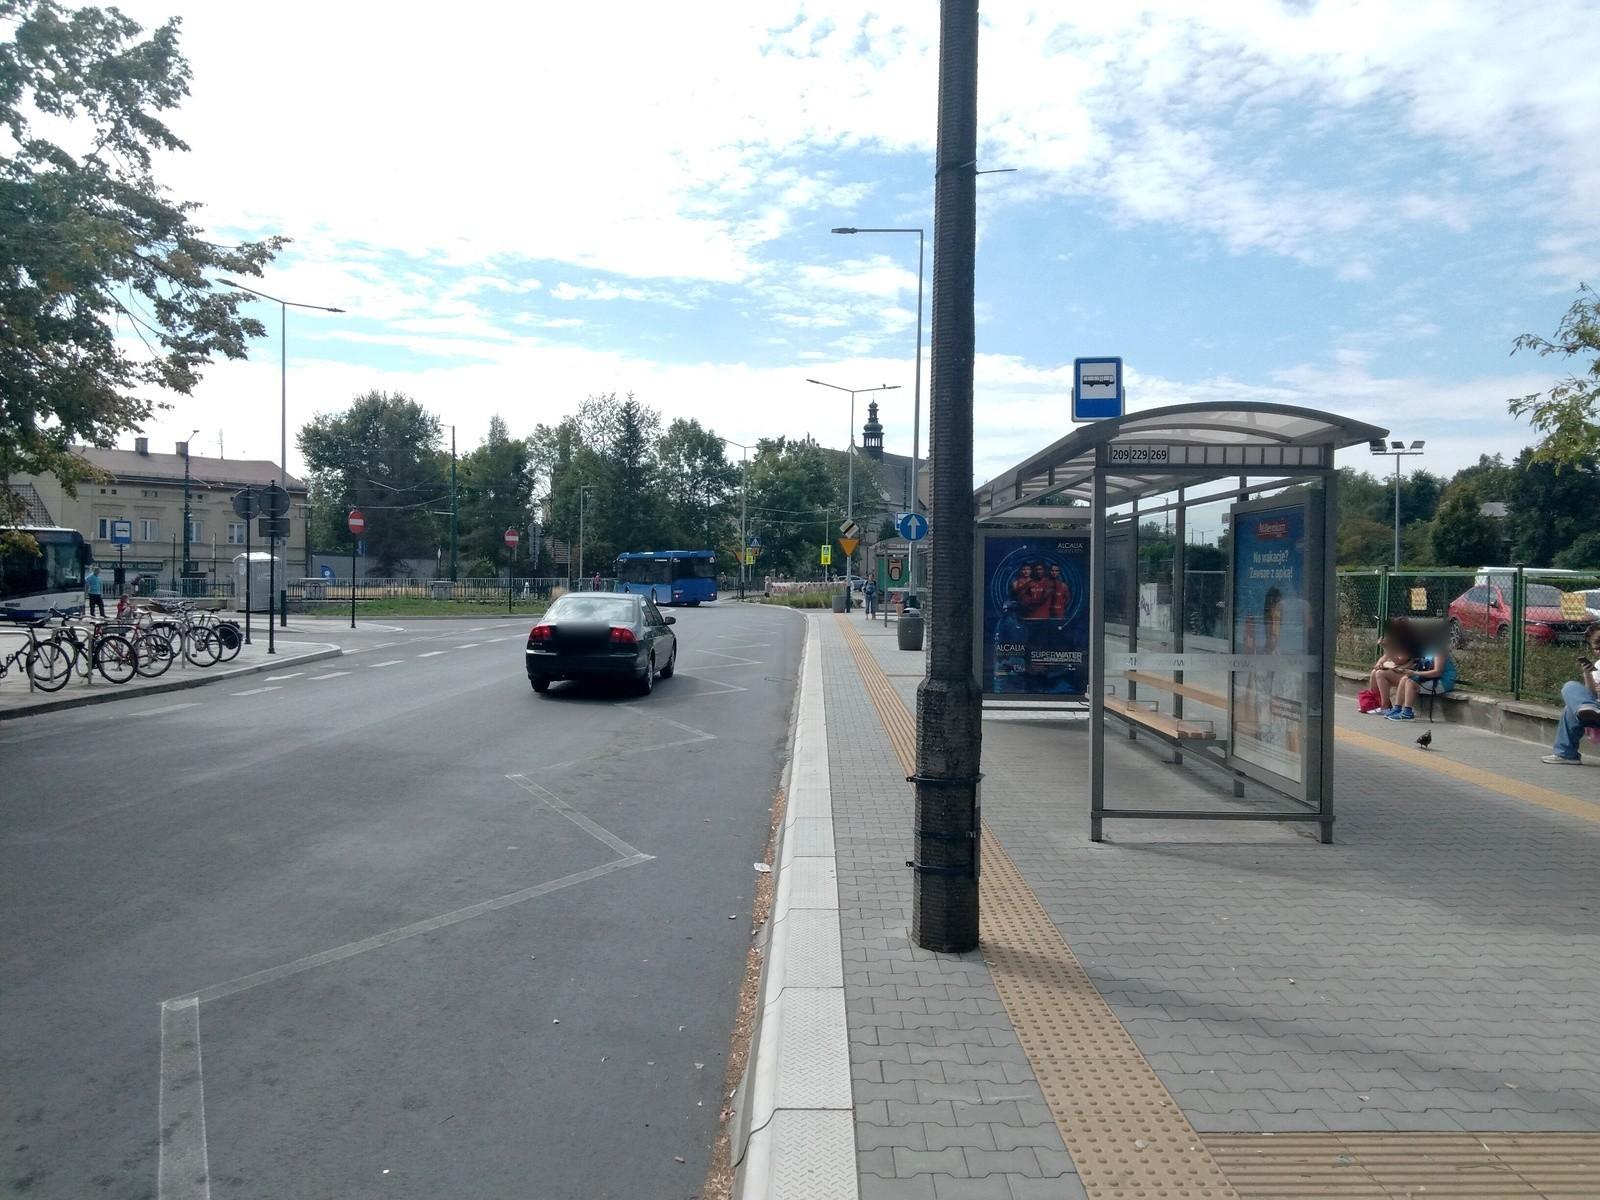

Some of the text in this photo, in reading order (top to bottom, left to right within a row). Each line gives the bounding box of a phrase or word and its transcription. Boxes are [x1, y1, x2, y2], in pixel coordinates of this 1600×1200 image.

[1112, 449, 1167, 460] 209 229 269
[1030, 650, 1083, 659] SUPERWATER
